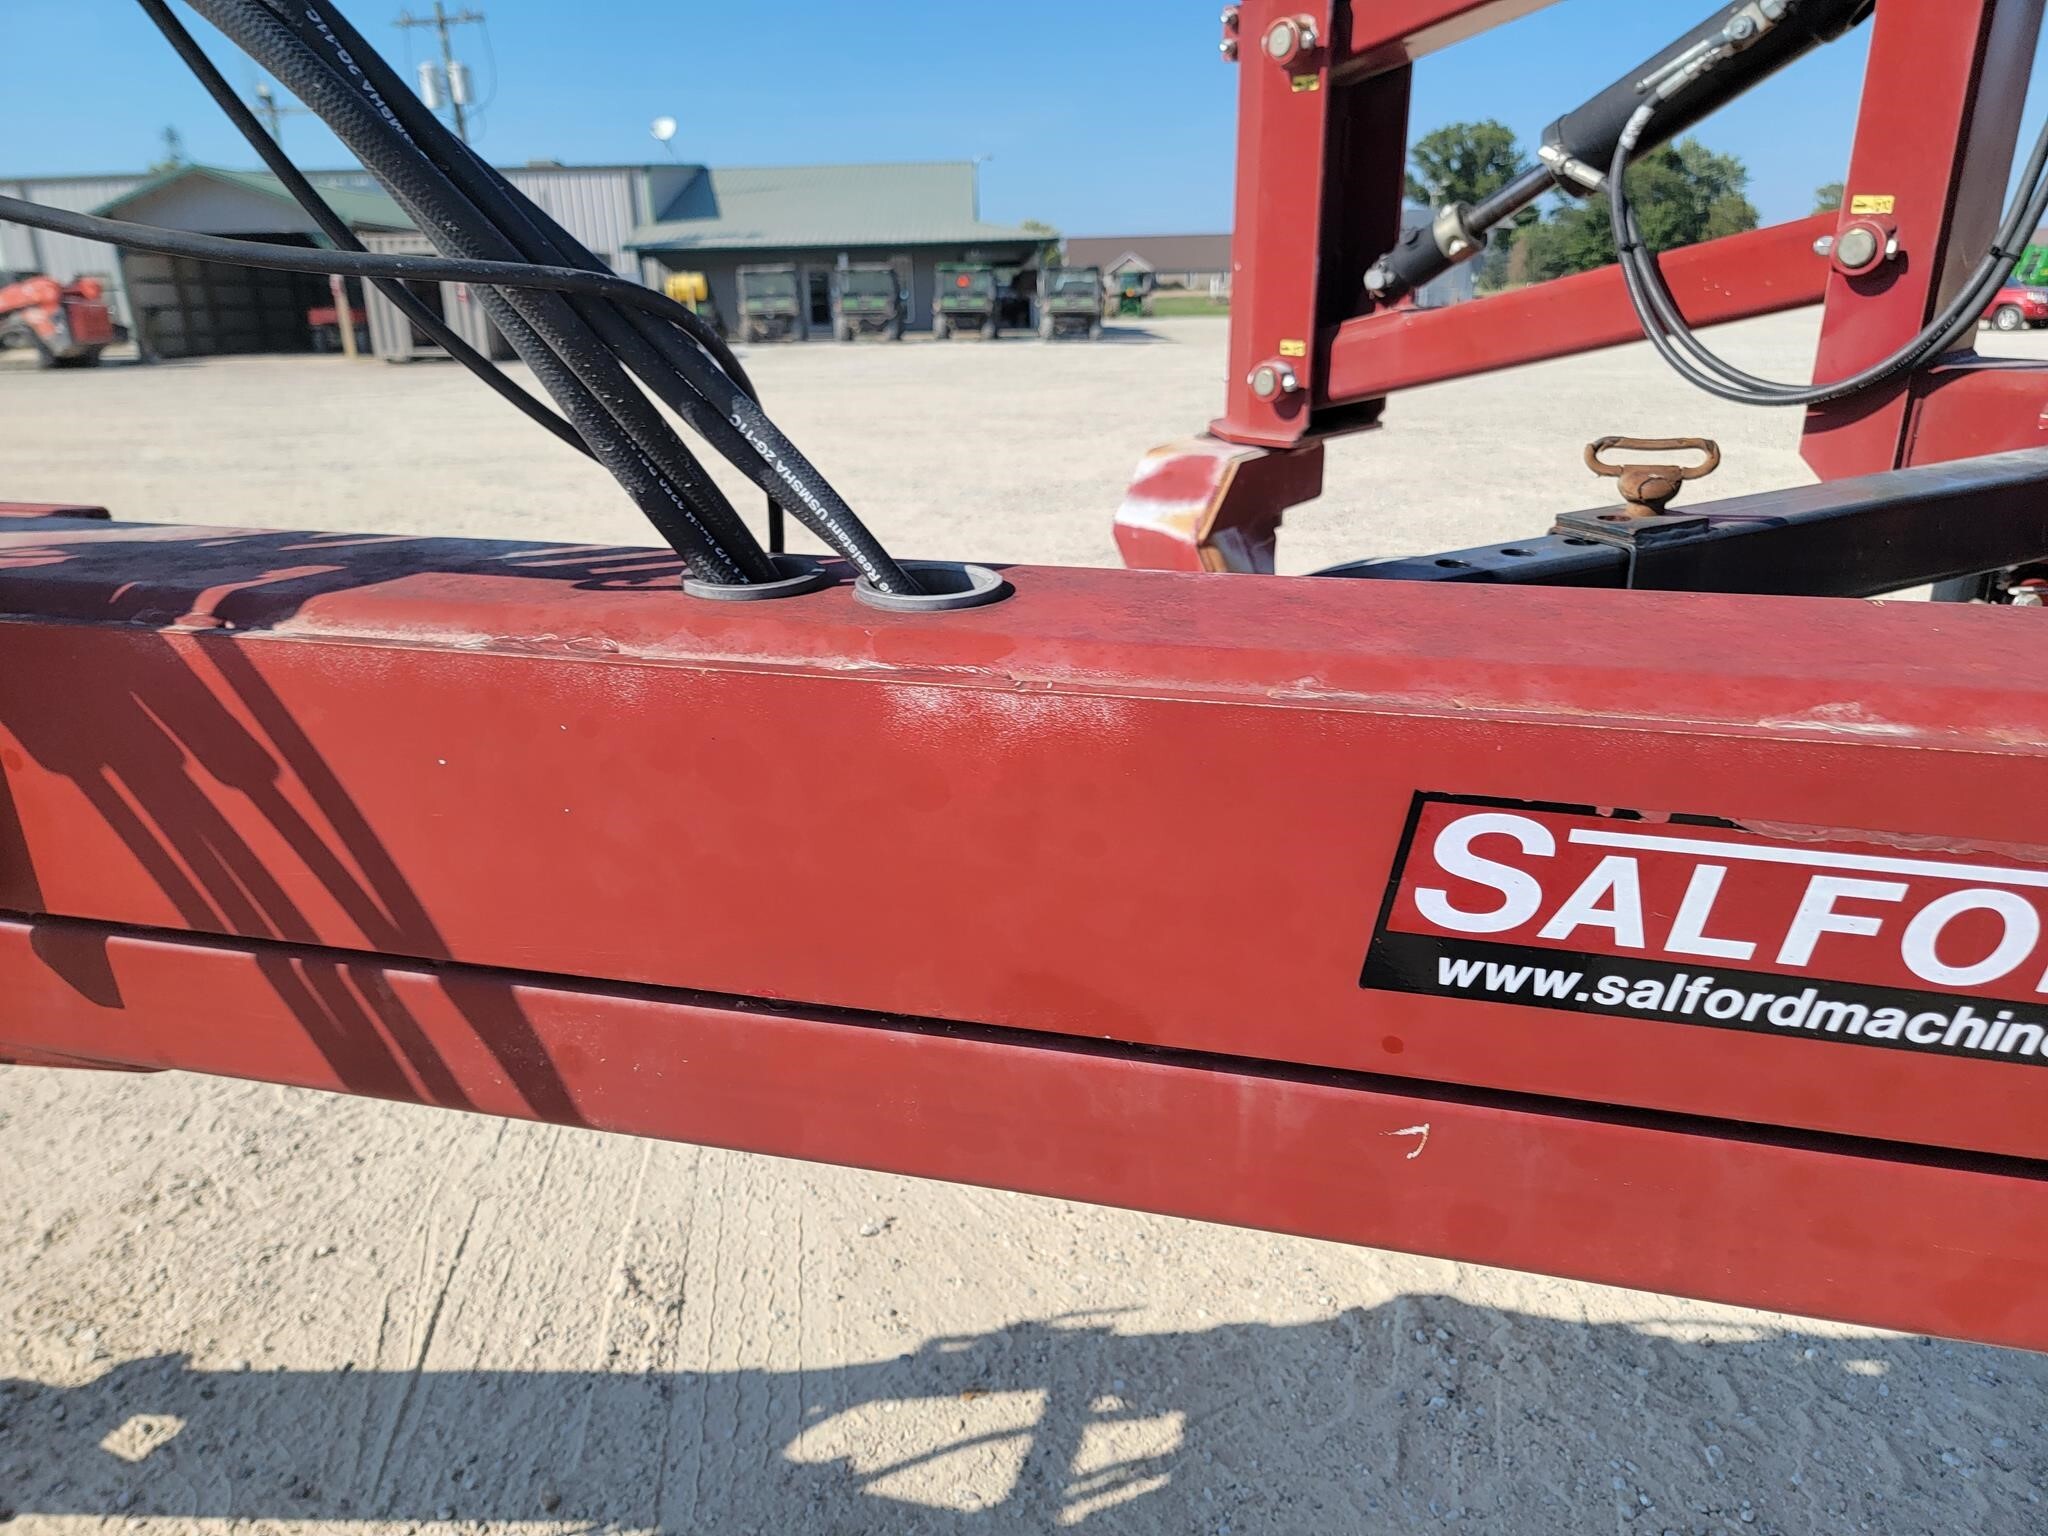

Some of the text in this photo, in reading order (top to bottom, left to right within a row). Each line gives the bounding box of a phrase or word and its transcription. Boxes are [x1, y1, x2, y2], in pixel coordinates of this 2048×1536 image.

[305, 9, 362, 76] 2G-11C
[729, 413, 777, 463] 2G-11C
[776, 459, 829, 521] USMSHA
[825, 517, 882, 582] Resistant
[1414, 813, 2048, 993] SALFO
[1437, 957, 2048, 1058] www.salfordmachin
